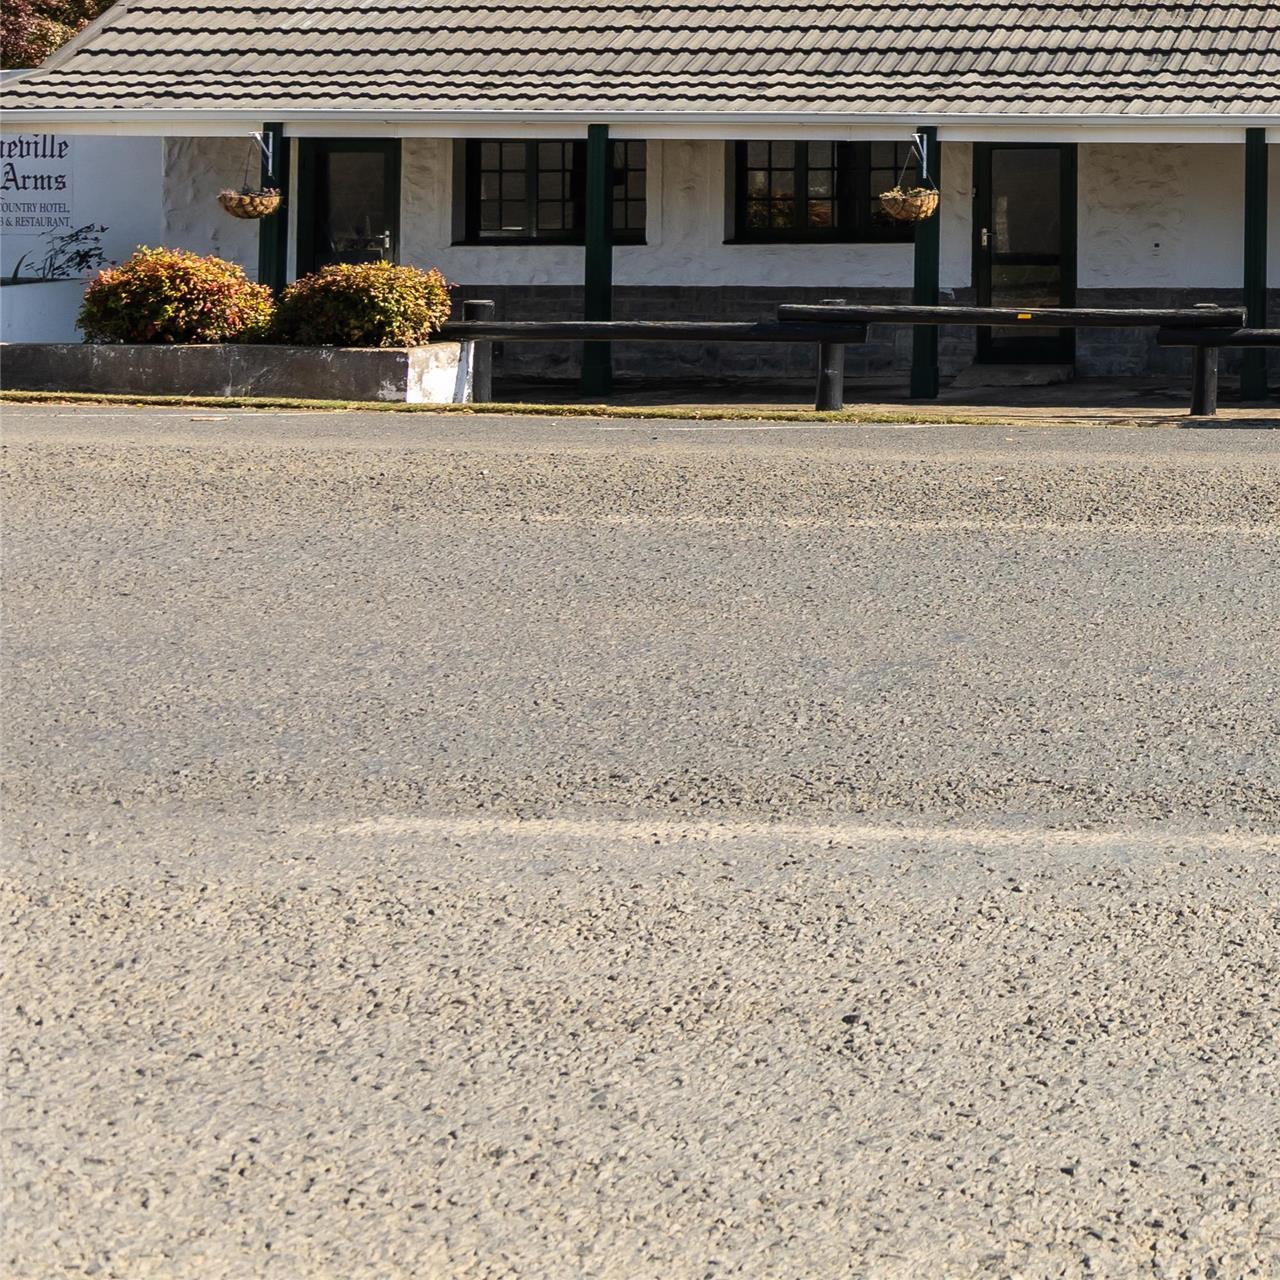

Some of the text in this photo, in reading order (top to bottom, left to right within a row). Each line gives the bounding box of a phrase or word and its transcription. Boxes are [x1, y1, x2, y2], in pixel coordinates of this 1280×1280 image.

[0, 162, 67, 199] Arms
[0, 202, 37, 213] OUNTRY
[6, 216, 13, 227] &
[15, 216, 70, 227] RESTAURANT
